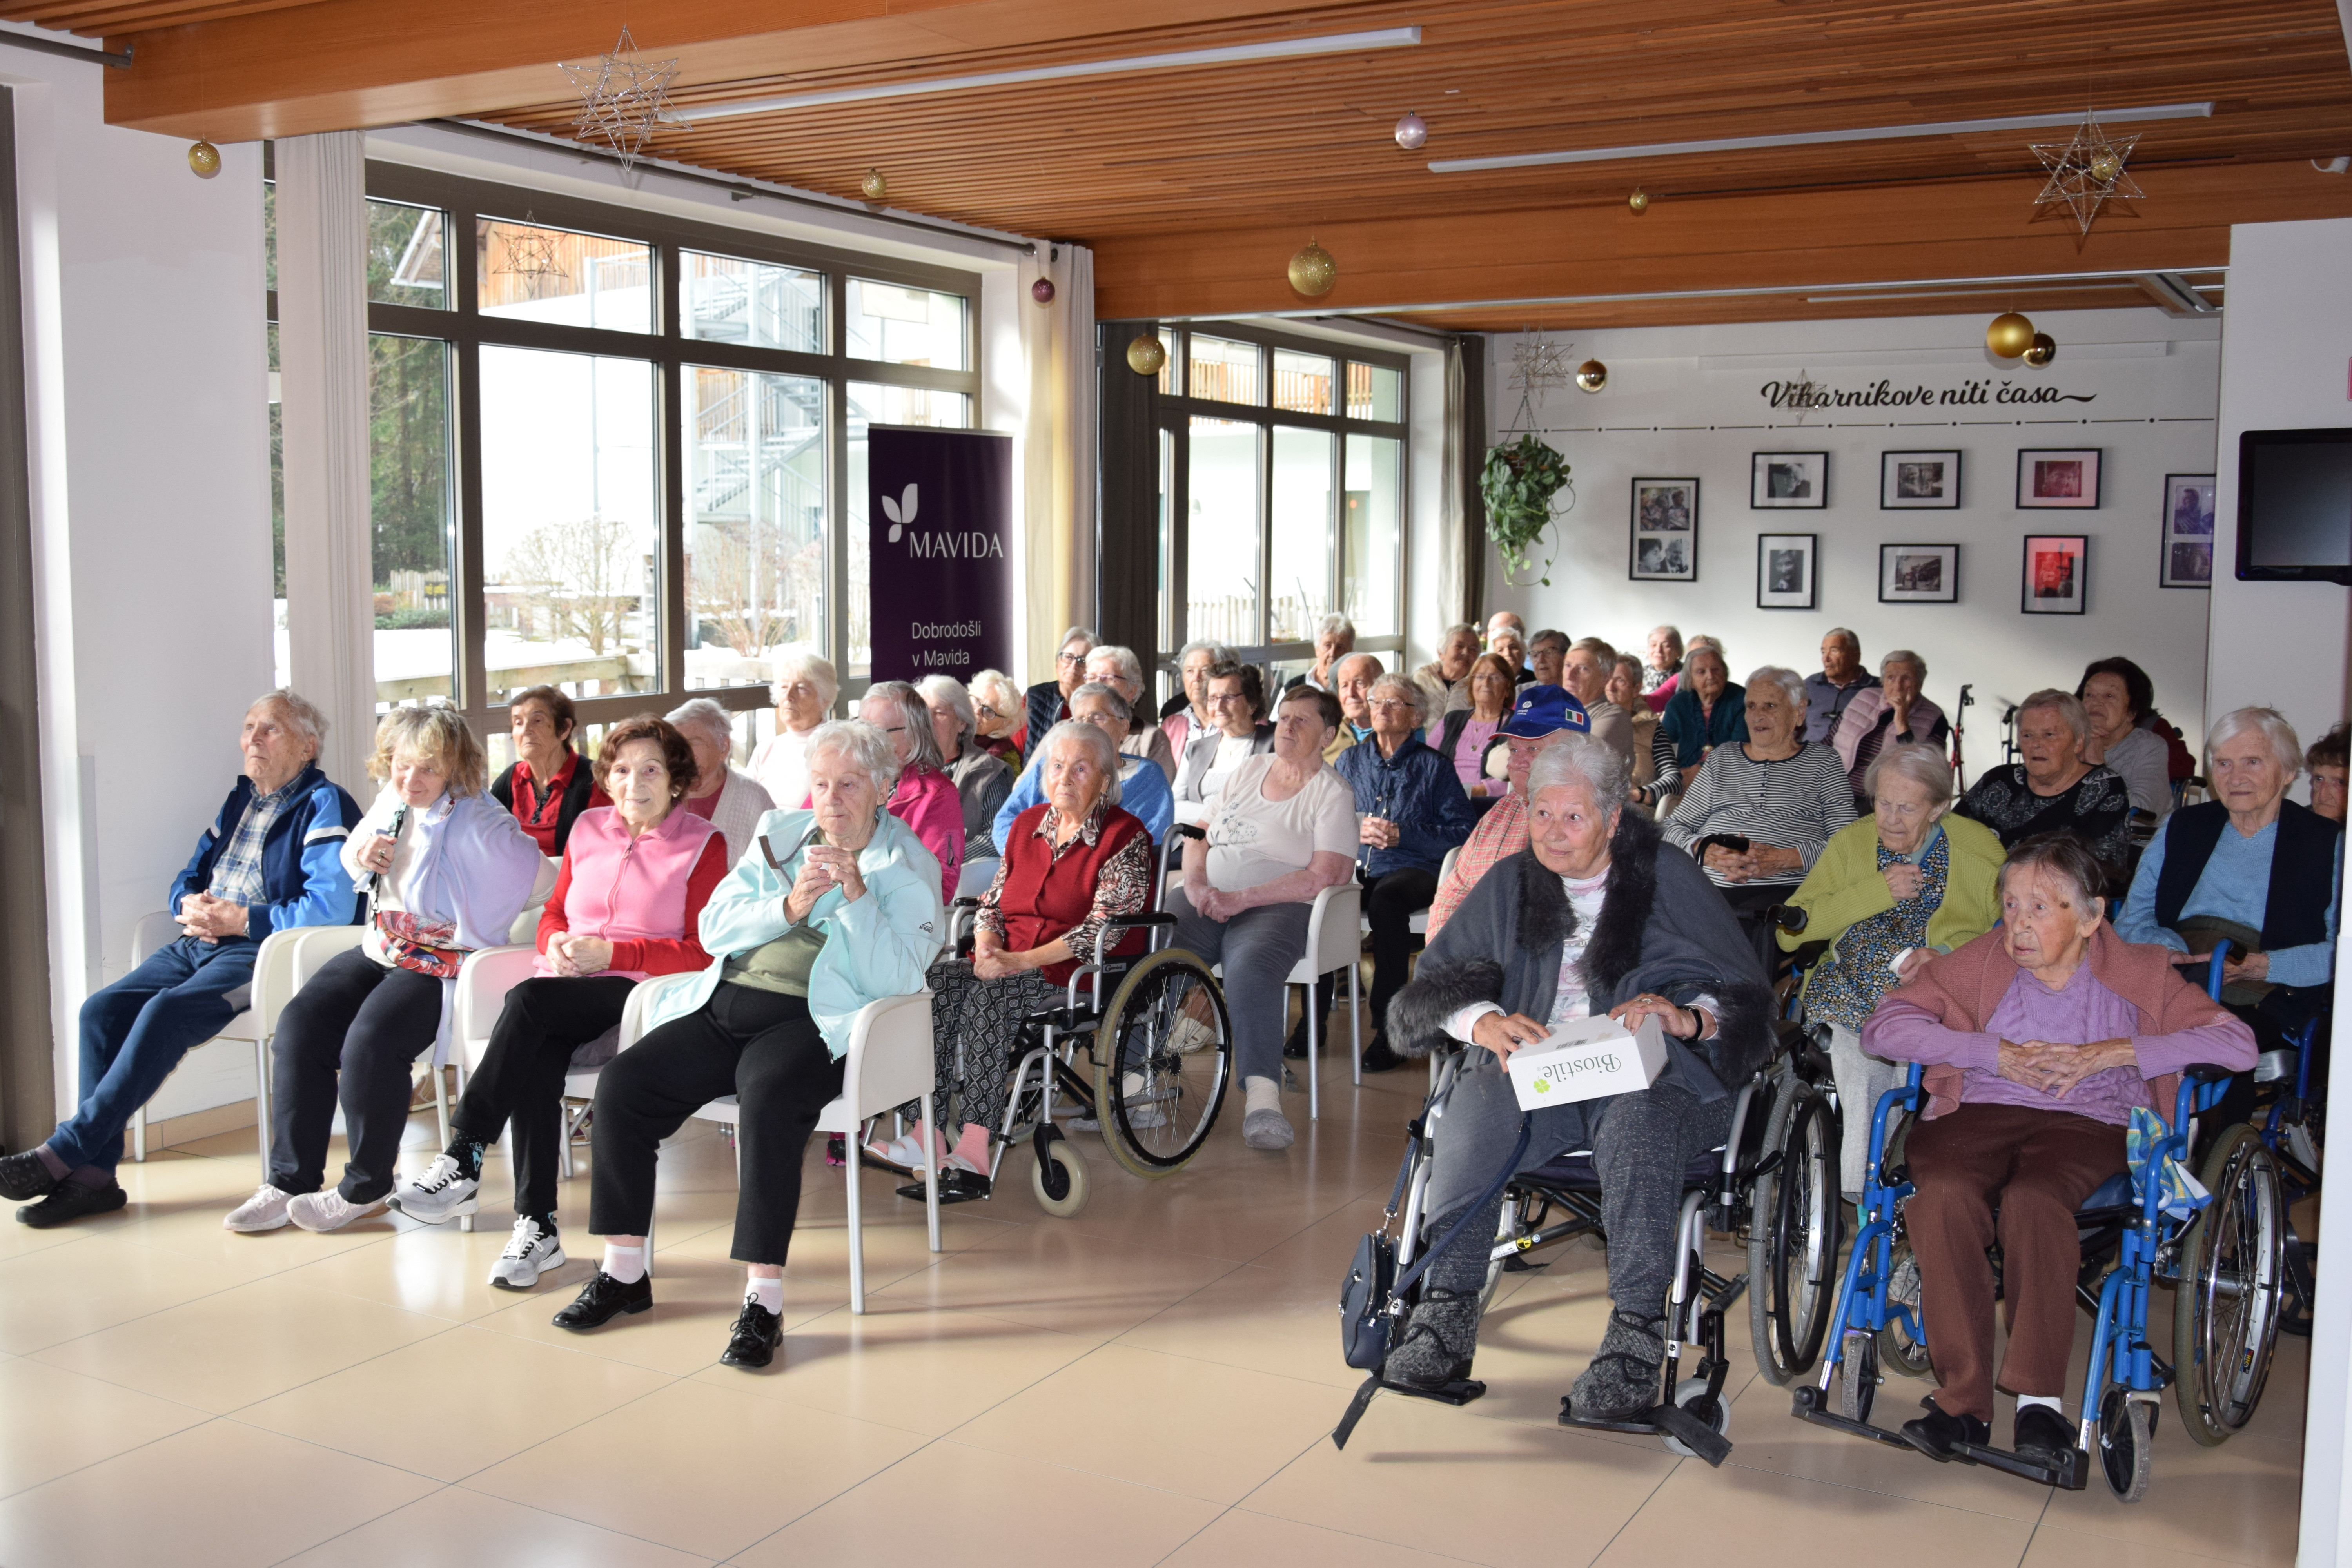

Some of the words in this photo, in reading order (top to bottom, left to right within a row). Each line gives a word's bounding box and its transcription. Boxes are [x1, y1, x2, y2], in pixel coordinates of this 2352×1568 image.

[1761, 379, 1934, 408] Viharnikove
[1940, 379, 1989, 405] niti
[1996, 380, 2096, 404] časa
[910, 532, 1004, 558] MAVIDA
[912, 620, 981, 639] Dobrodošli
[912, 654, 920, 667] v
[924, 648, 970, 666] Mavida
[1542, 1053, 1621, 1082] Biostile
